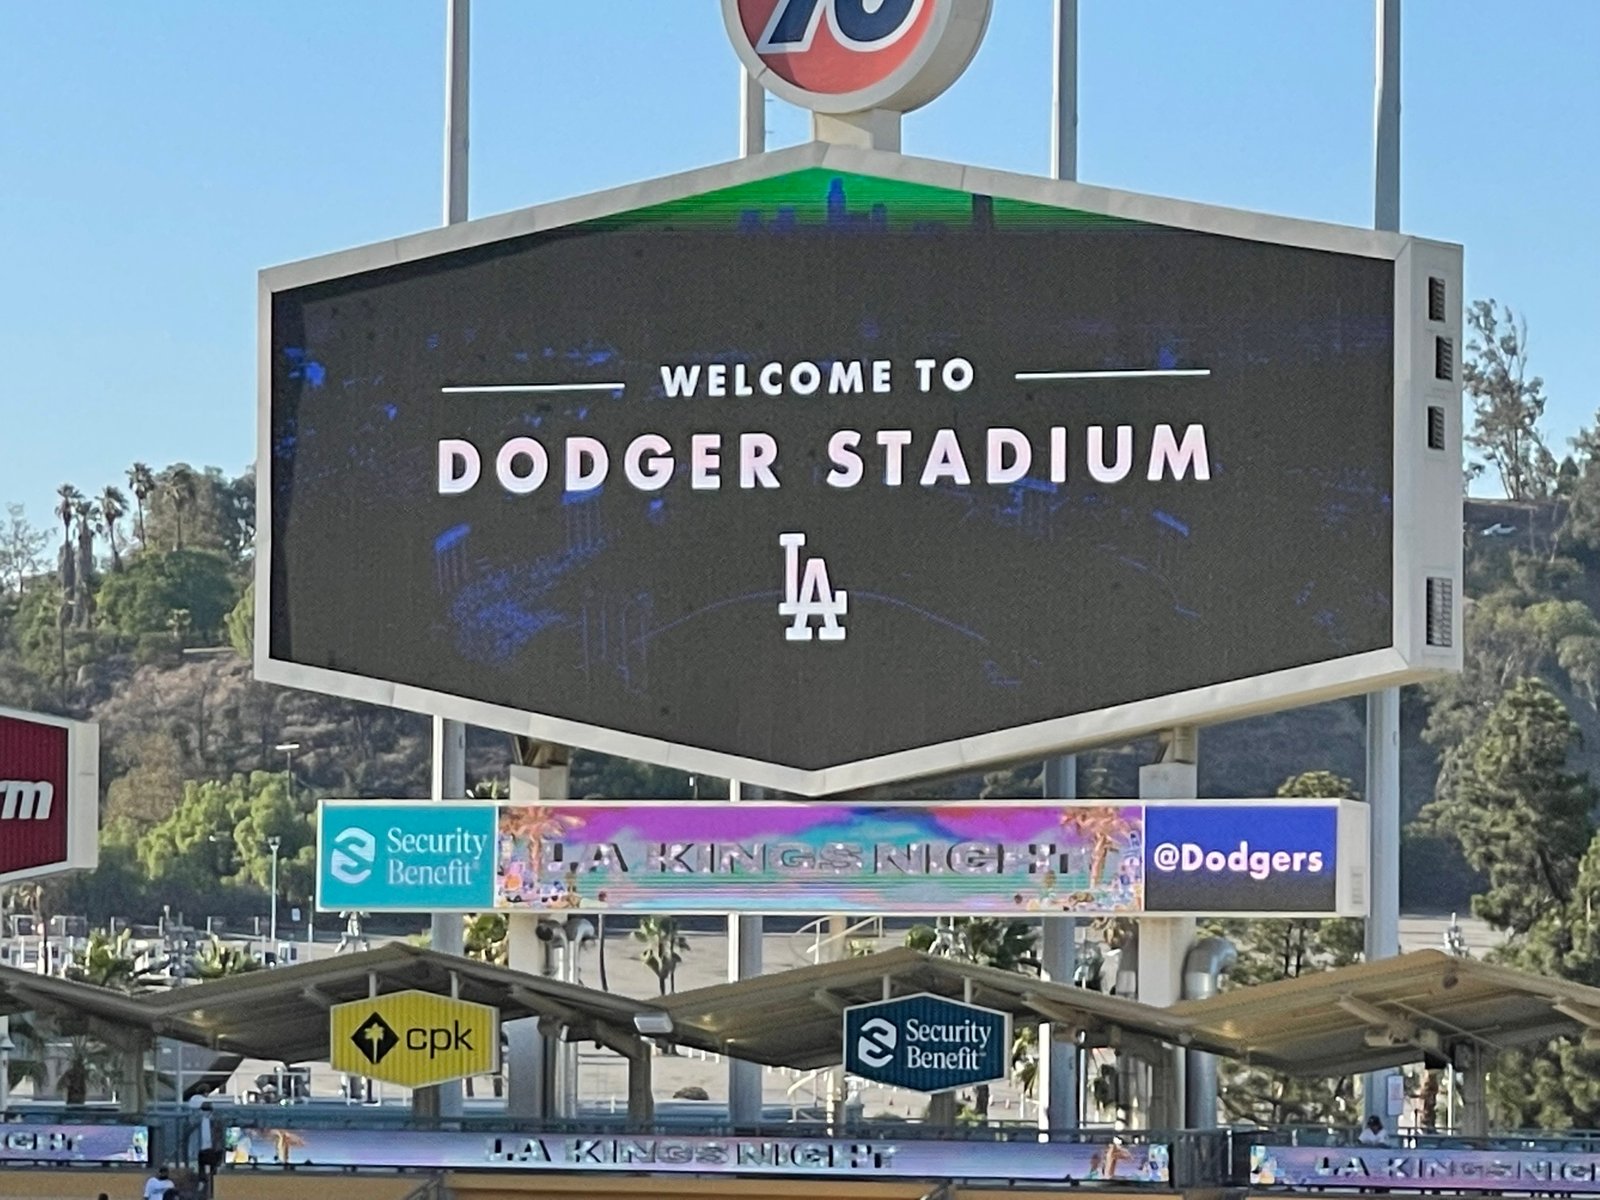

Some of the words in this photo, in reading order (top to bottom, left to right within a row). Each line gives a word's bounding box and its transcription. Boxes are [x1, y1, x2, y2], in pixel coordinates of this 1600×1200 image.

[660, 360, 893, 398] WELCOME
[914, 357, 976, 393] TO
[436, 431, 781, 496] DODGER
[826, 423, 1213, 488] STADIUM
[778, 532, 848, 641] LA
[386, 827, 488, 860] Security
[1152, 841, 1324, 880] @Dodgers
[388, 859, 472, 885] Benefit
[406, 1020, 473, 1059] cpk
[906, 1018, 992, 1048] Security
[907, 1046, 981, 1070] Benefit
